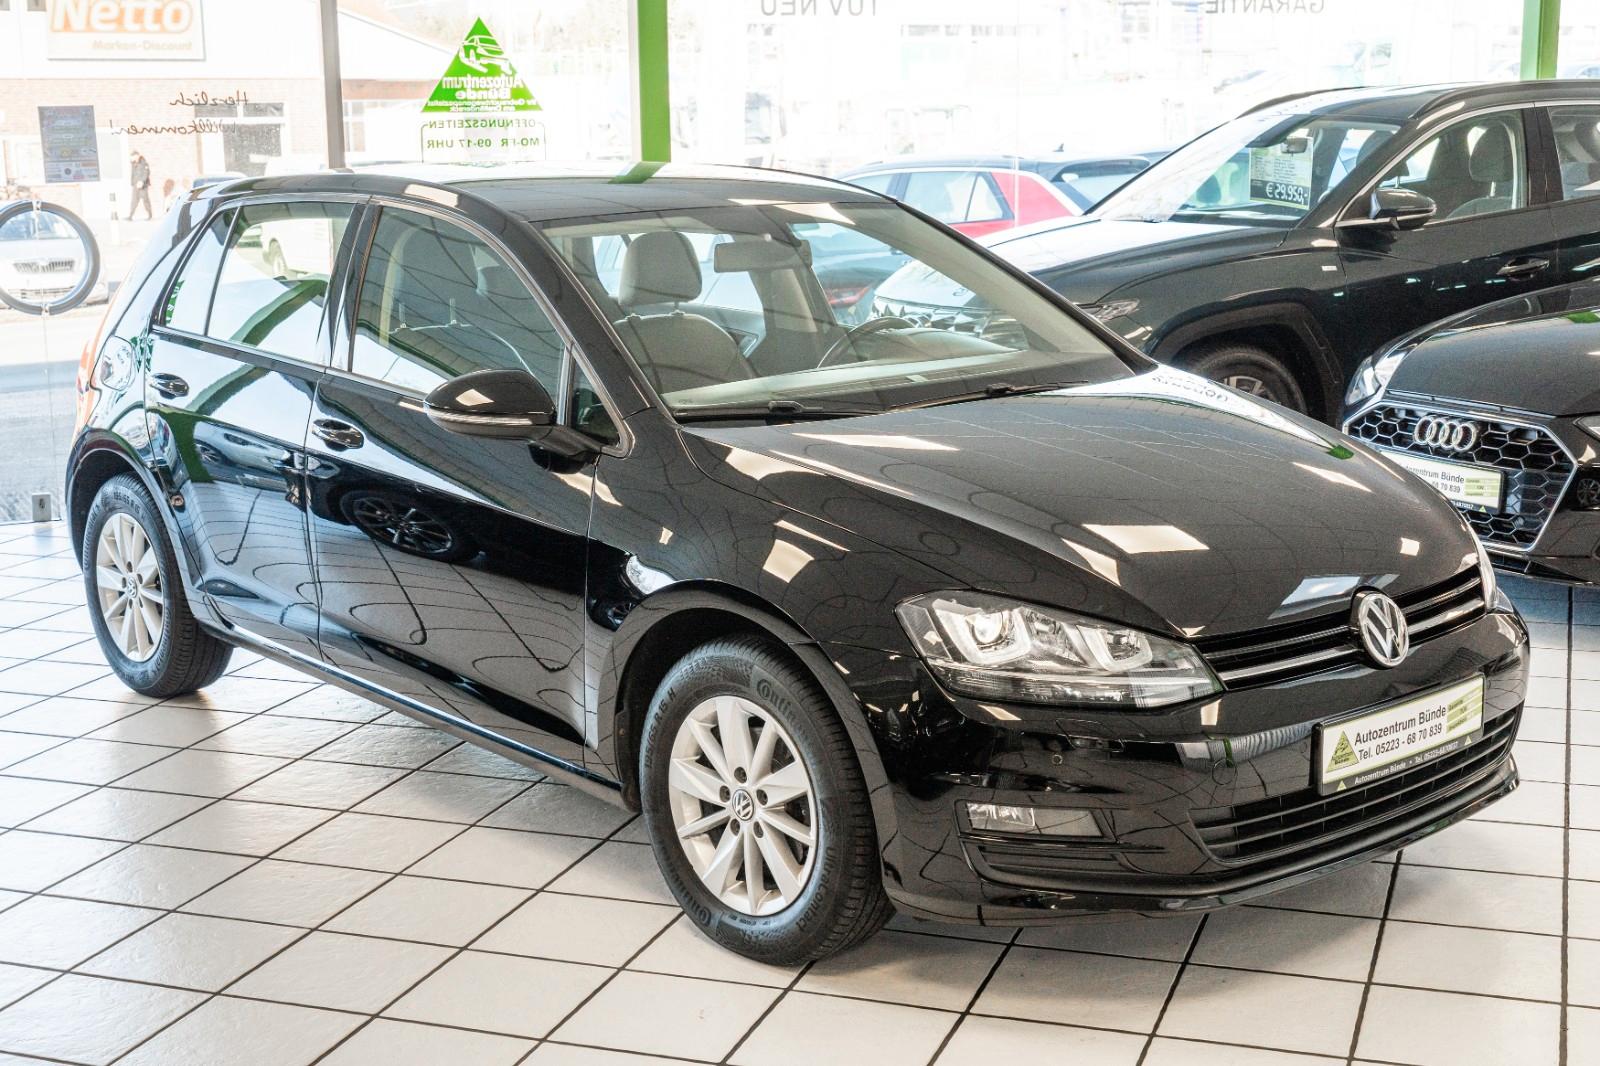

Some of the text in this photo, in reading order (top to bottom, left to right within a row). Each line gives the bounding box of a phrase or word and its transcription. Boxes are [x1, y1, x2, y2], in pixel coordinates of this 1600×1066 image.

[50, 0, 192, 32] Netto
[1441, 471, 1465, 484] Bünde
[1354, 716, 1417, 747] Autozentrum
[1418, 705, 1447, 725] Bünde
[1358, 747, 1373, 761] Tel.
[1375, 738, 1400, 756] 05223
[1406, 732, 1416, 745] 68
[1418, 728, 1428, 742] 70
[1429, 722, 1443, 737] 839
[644, 723, 657, 769] 195/65
[1354, 768, 1390, 785] Autozentrum
[1390, 761, 1407, 774] Bünde
[795, 845, 838, 933] UltraContact
